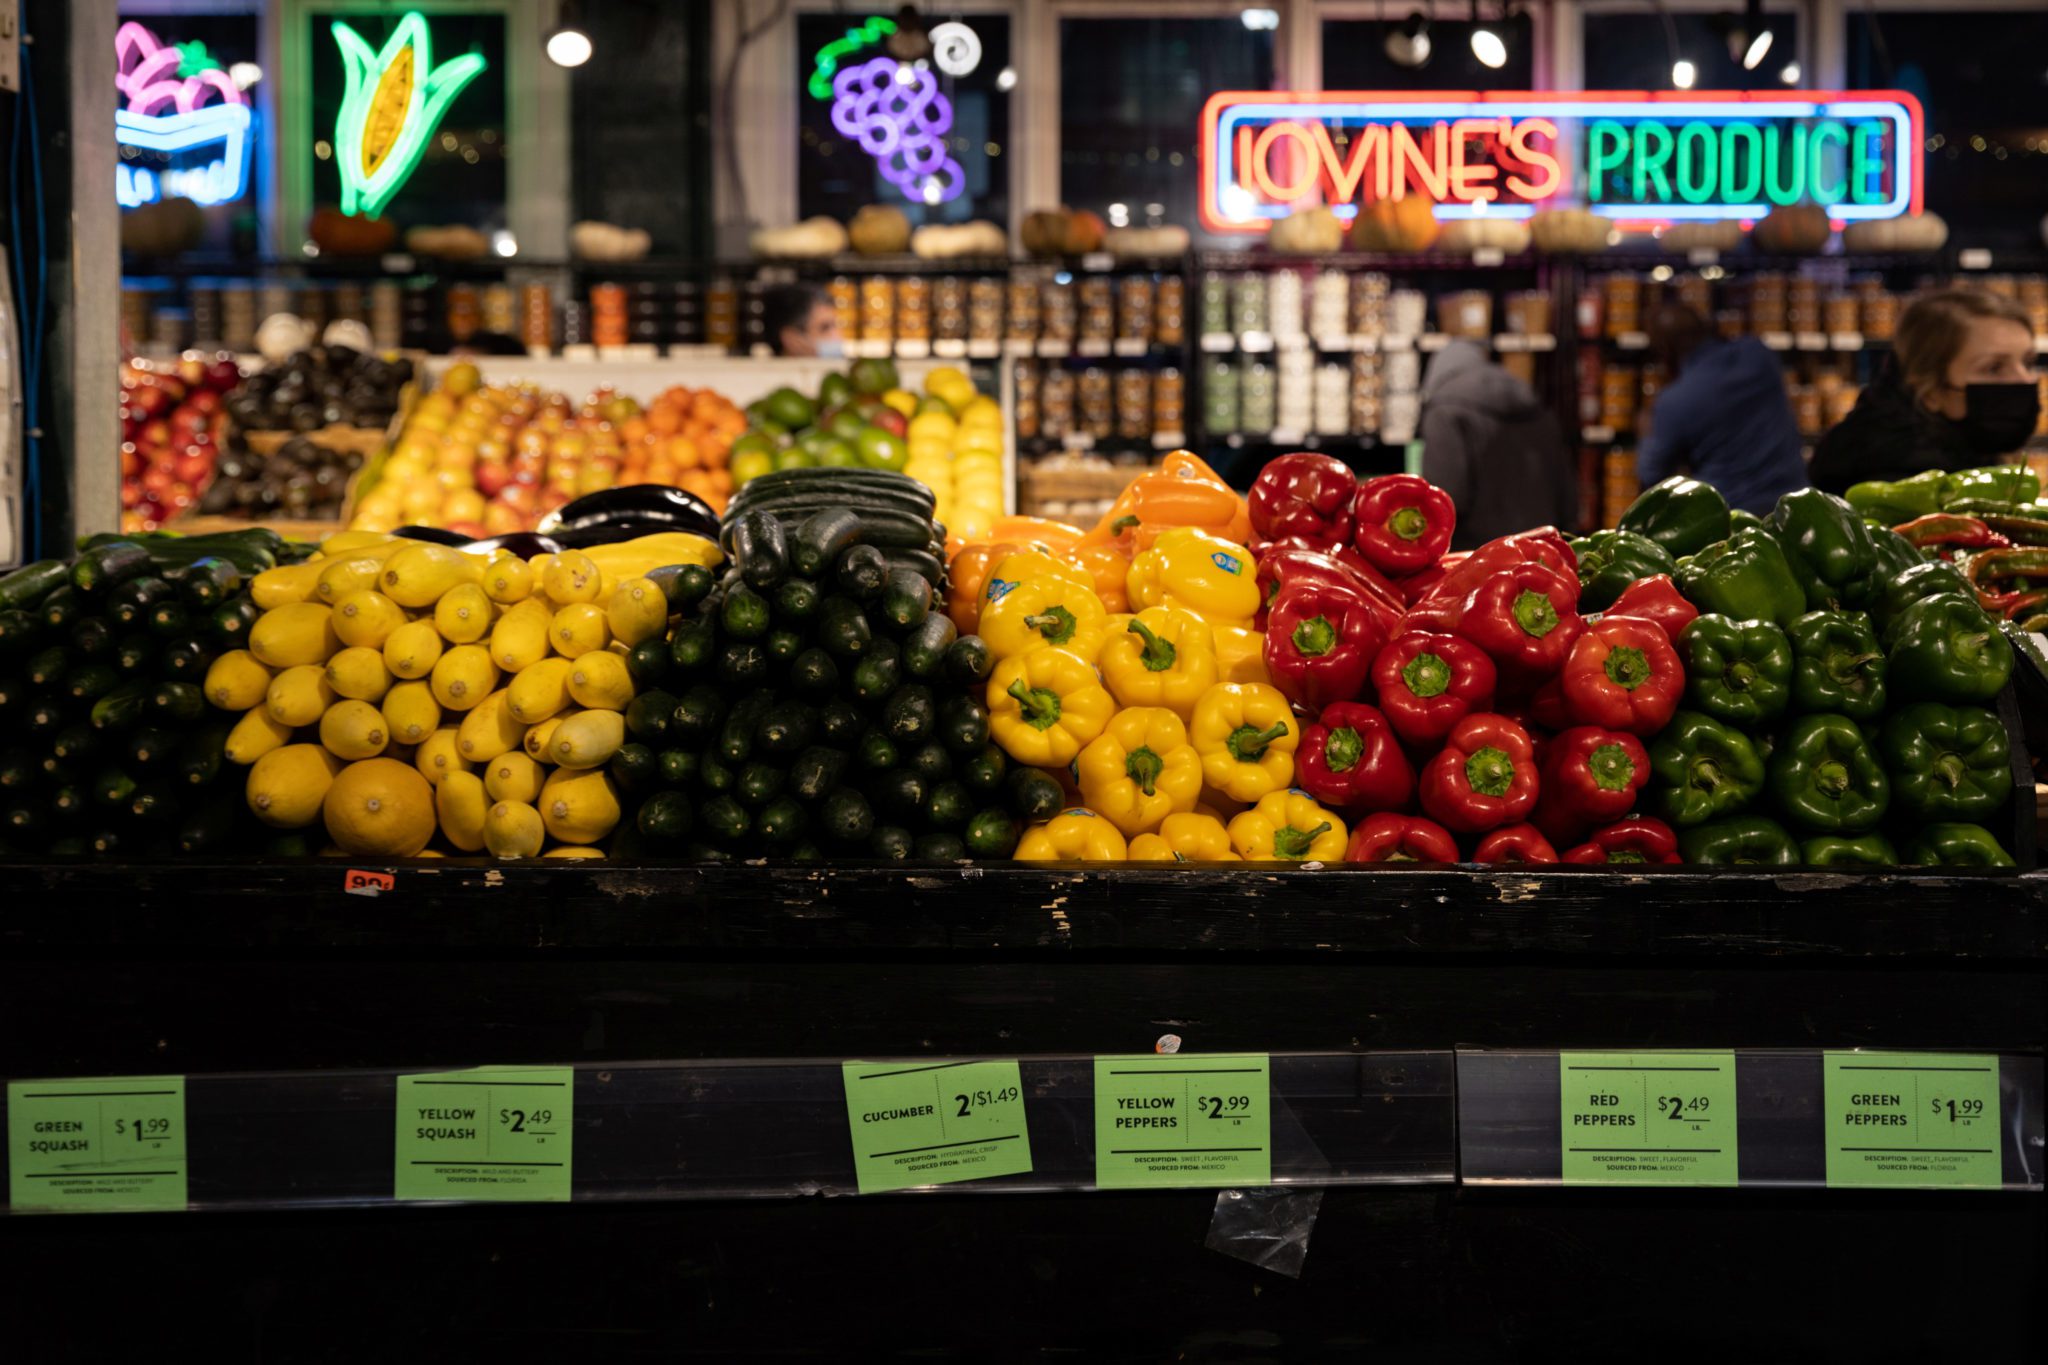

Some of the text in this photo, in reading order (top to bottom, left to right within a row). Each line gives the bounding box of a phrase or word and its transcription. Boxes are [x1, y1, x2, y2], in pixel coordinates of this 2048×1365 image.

[1238, 116, 1890, 206] IOVINE'S PRODUCE
[955, 1086, 1018, 1118] 2/$1.49
[1117, 1098, 1175, 1109] YELLOW
[1590, 1094, 1619, 1106] RED
[1851, 1094, 1900, 1106] GREEN
[862, 1105, 934, 1123] CUCUMBER
[1198, 1096, 1249, 1119] $2.99
[1658, 1096, 1710, 1120] $2.49
[1932, 1098, 1983, 1122] $1.99
[418, 1109, 476, 1120] YELLOW
[500, 1109, 552, 1133] $2.49
[1574, 1115, 1636, 1126] PEPPERS
[1846, 1114, 1907, 1126] PEPPERS
[34, 1121, 83, 1133] GREEN
[1116, 1117, 1177, 1128] PEPPERS
[115, 1118, 170, 1142] $1.99
[416, 1128, 476, 1141] SQUASH
[29, 1140, 89, 1155] SQUASH
[908, 1163, 938, 1172] SOURCED
